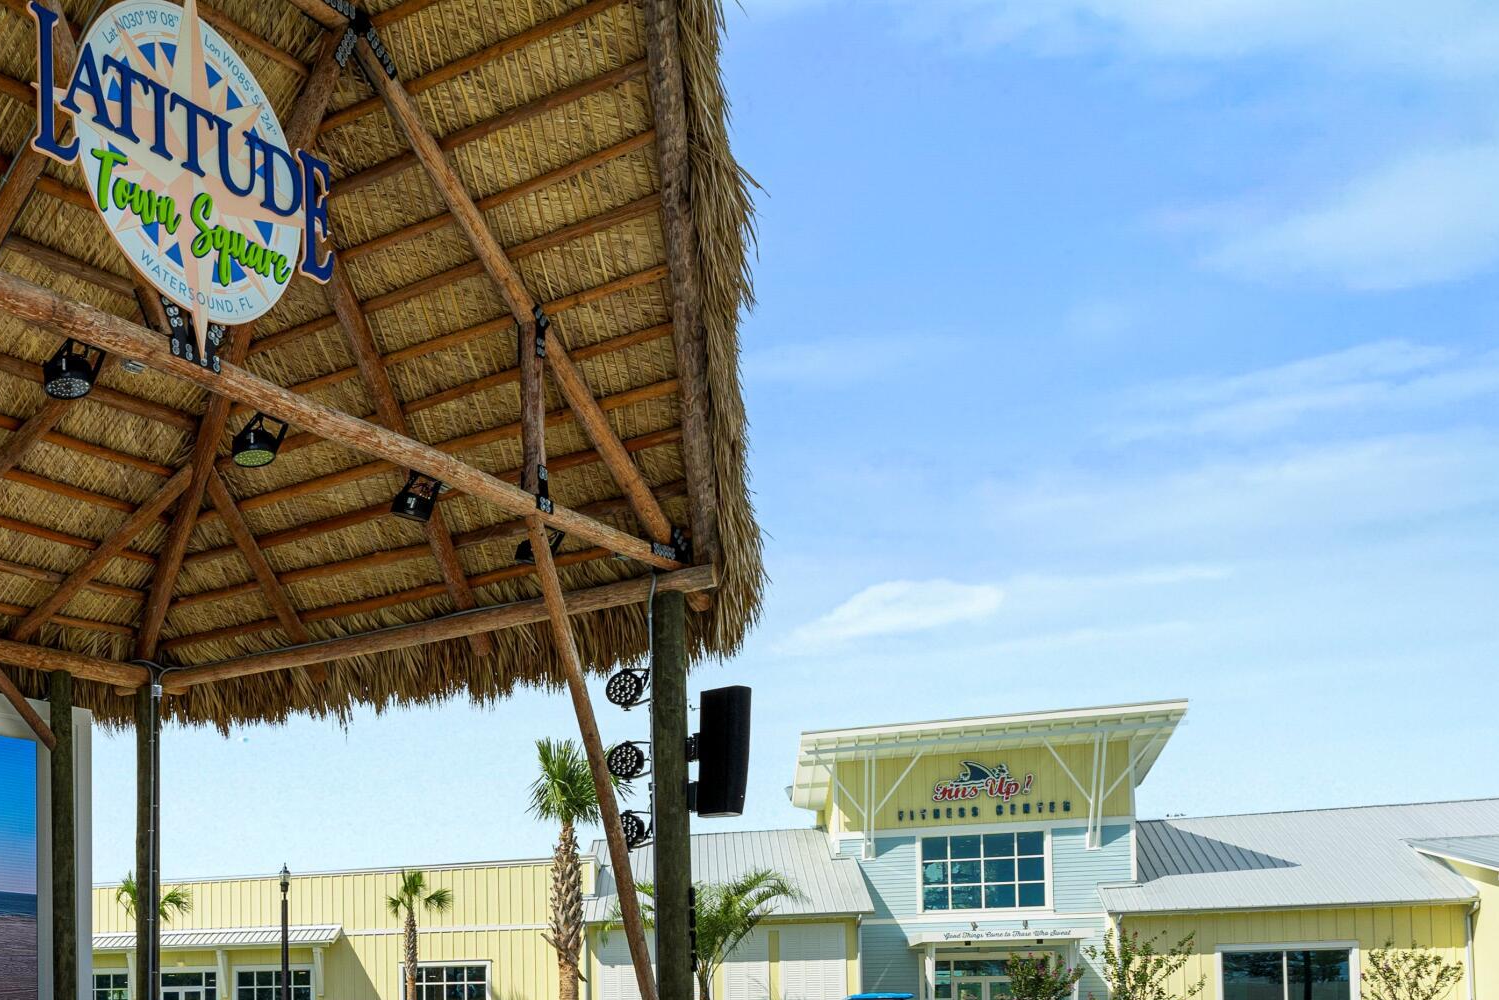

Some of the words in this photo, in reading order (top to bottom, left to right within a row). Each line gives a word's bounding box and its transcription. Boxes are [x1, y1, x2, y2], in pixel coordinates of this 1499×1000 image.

[102, 27, 118, 44] Lat
[204, 33, 221, 57] Lon
[29, 1, 335, 282] LATITUDE
[91, 147, 182, 235] Town
[190, 193, 292, 287] Square
[240, 296, 254, 310] FL
[932, 781, 980, 802] Fins
[897, 807, 979, 822] FITNESS
[995, 800, 1071, 817] CENTER
[943, 932, 961, 940] Good
